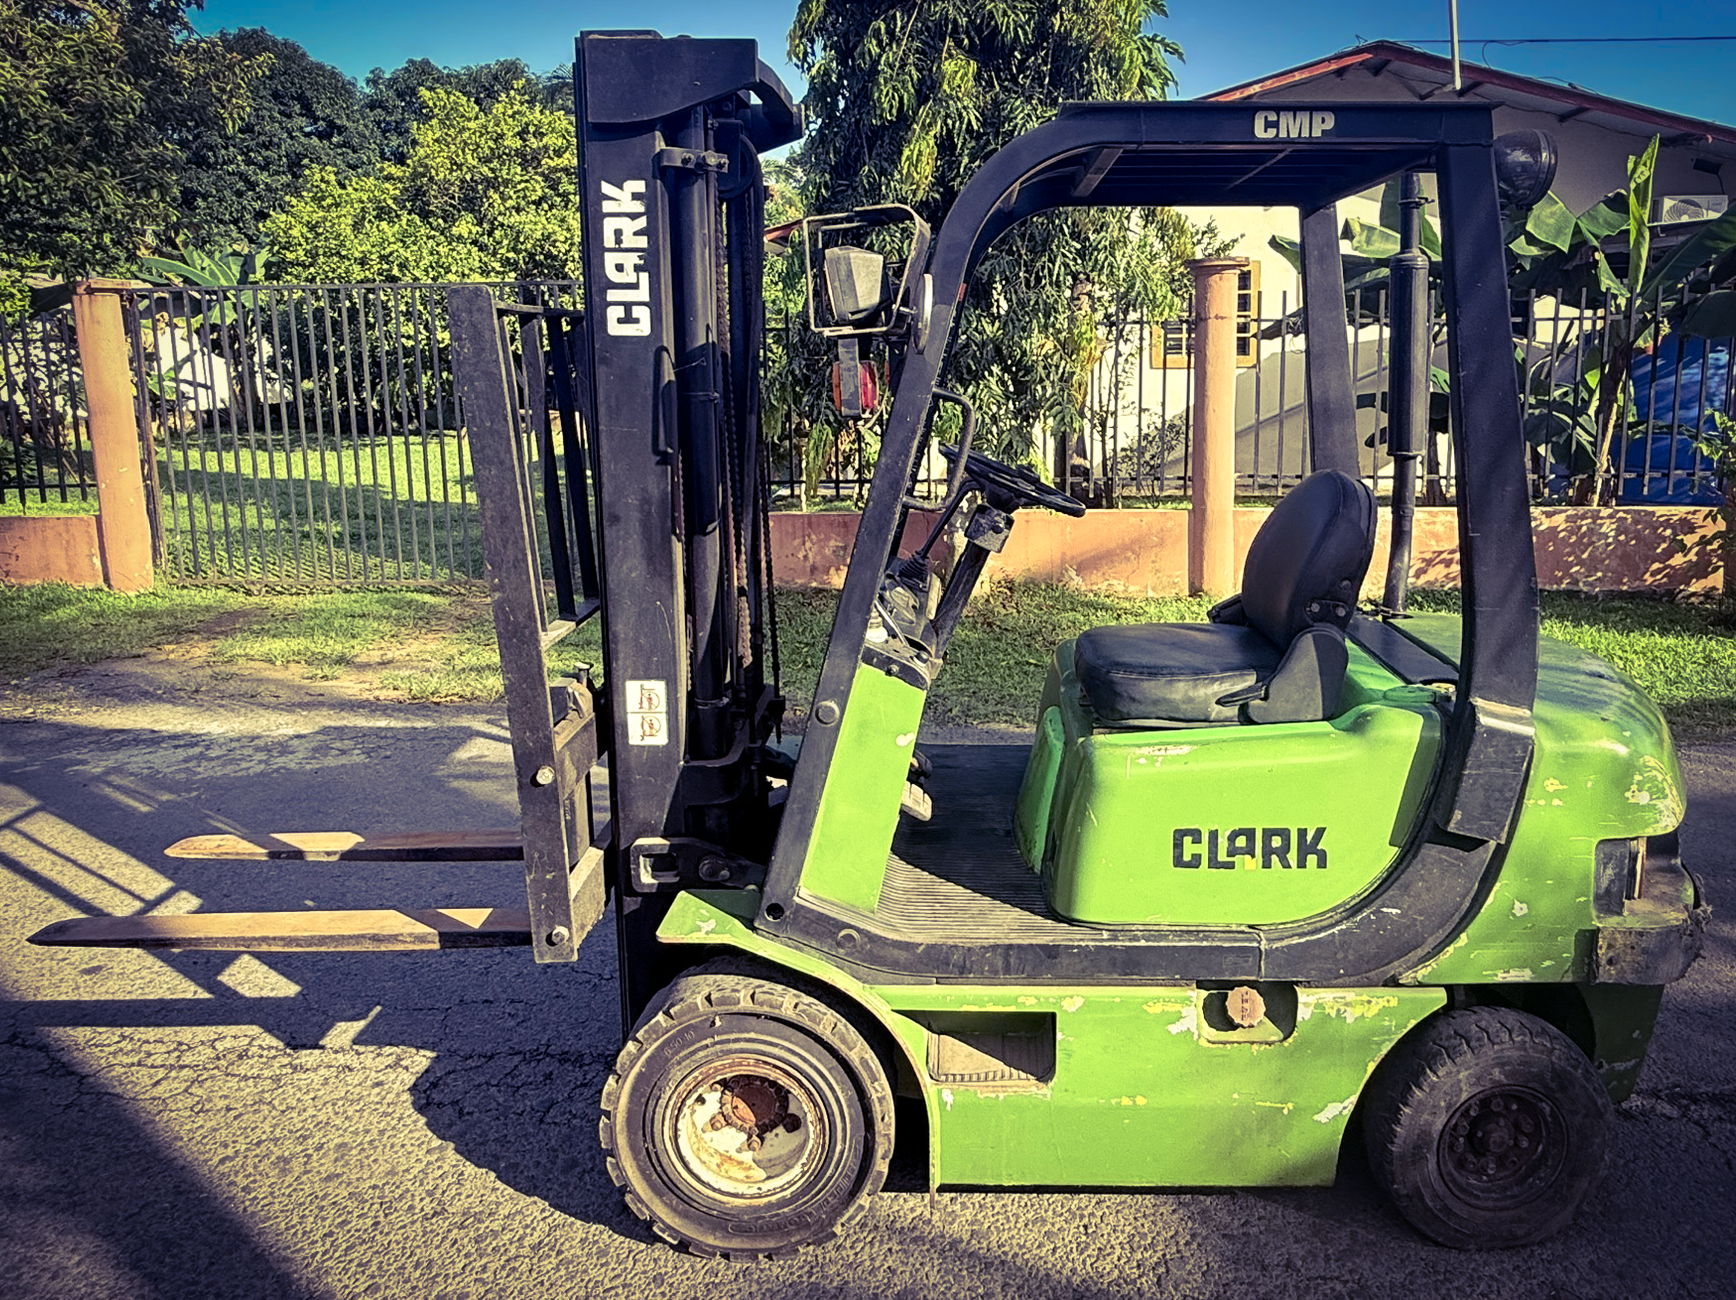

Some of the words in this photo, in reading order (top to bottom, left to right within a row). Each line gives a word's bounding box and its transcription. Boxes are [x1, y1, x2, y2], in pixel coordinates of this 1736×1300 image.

[1254, 110, 1335, 139] CMP
[601, 180, 651, 337] CLARK
[1172, 827, 1328, 870] CLARK
